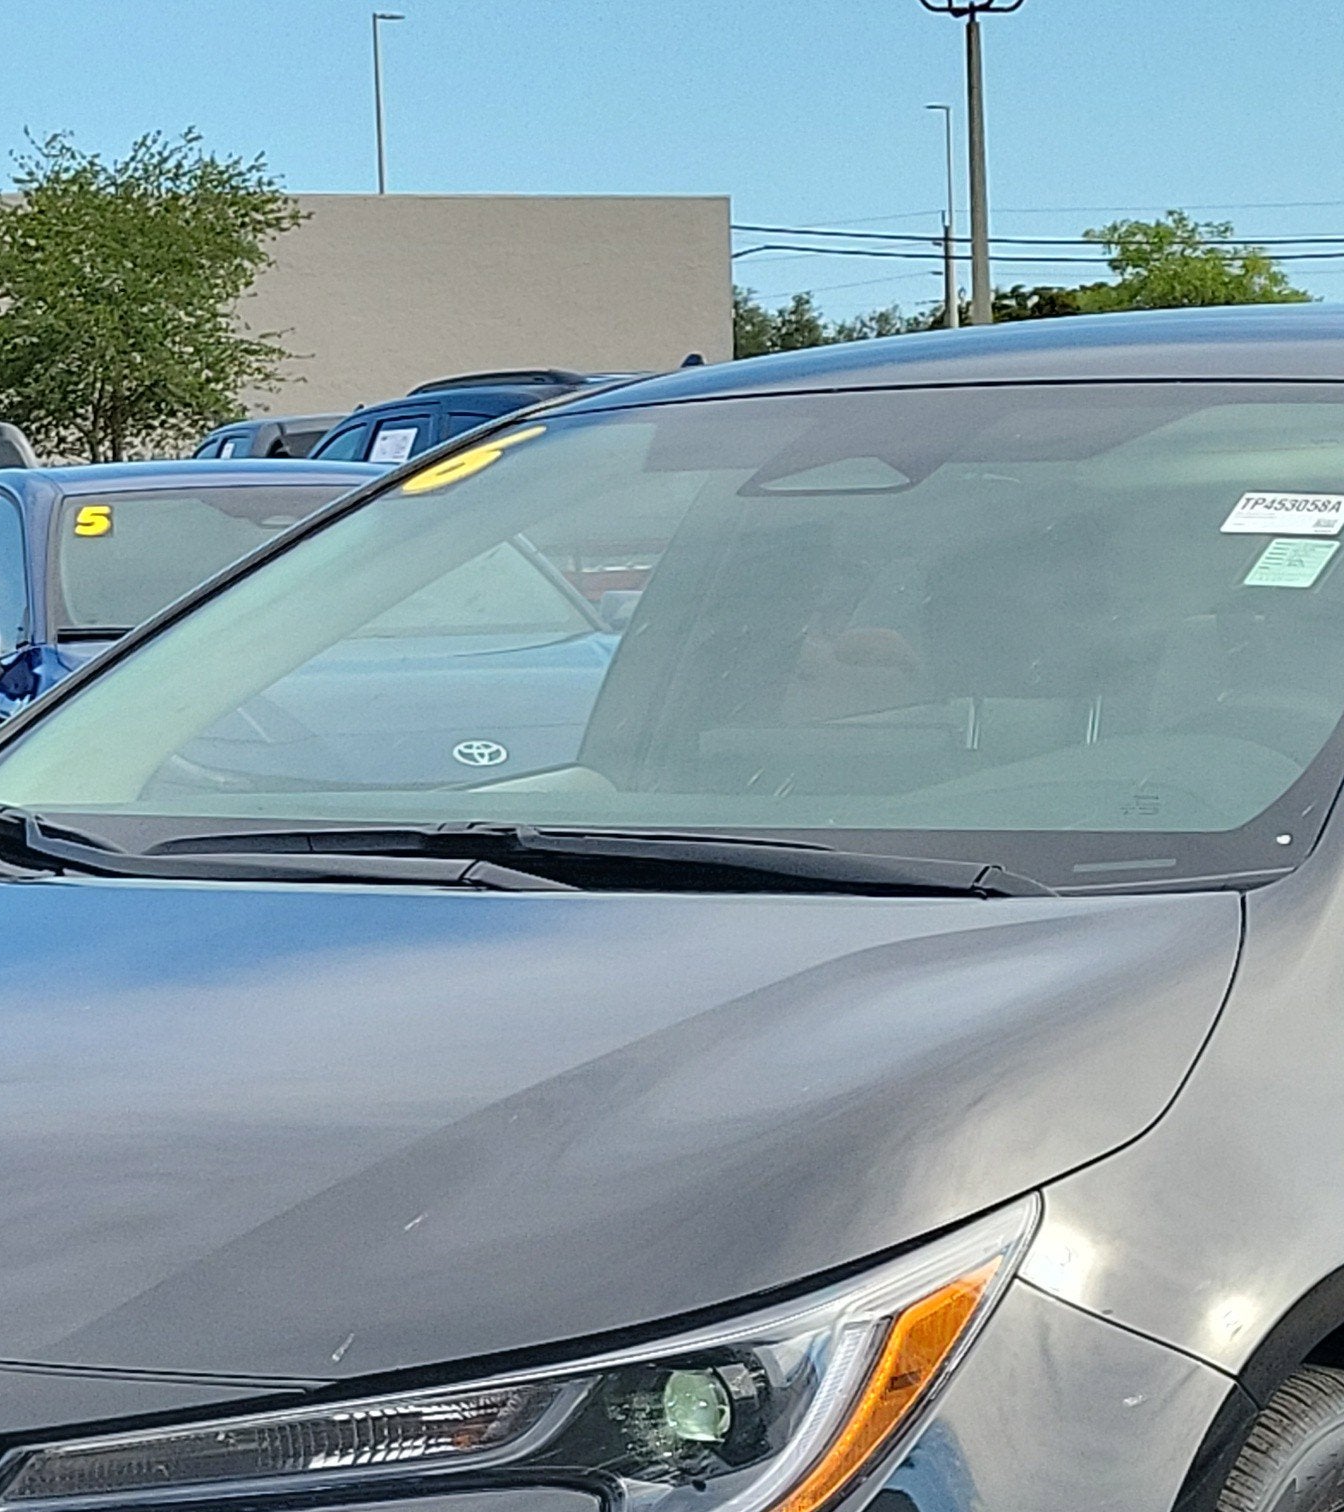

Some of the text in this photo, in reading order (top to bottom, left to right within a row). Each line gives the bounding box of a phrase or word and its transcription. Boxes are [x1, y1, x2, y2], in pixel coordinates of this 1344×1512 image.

[403, 425, 547, 495] 6
[74, 505, 112, 536] 5
[1240, 496, 1343, 514] TP453058A
